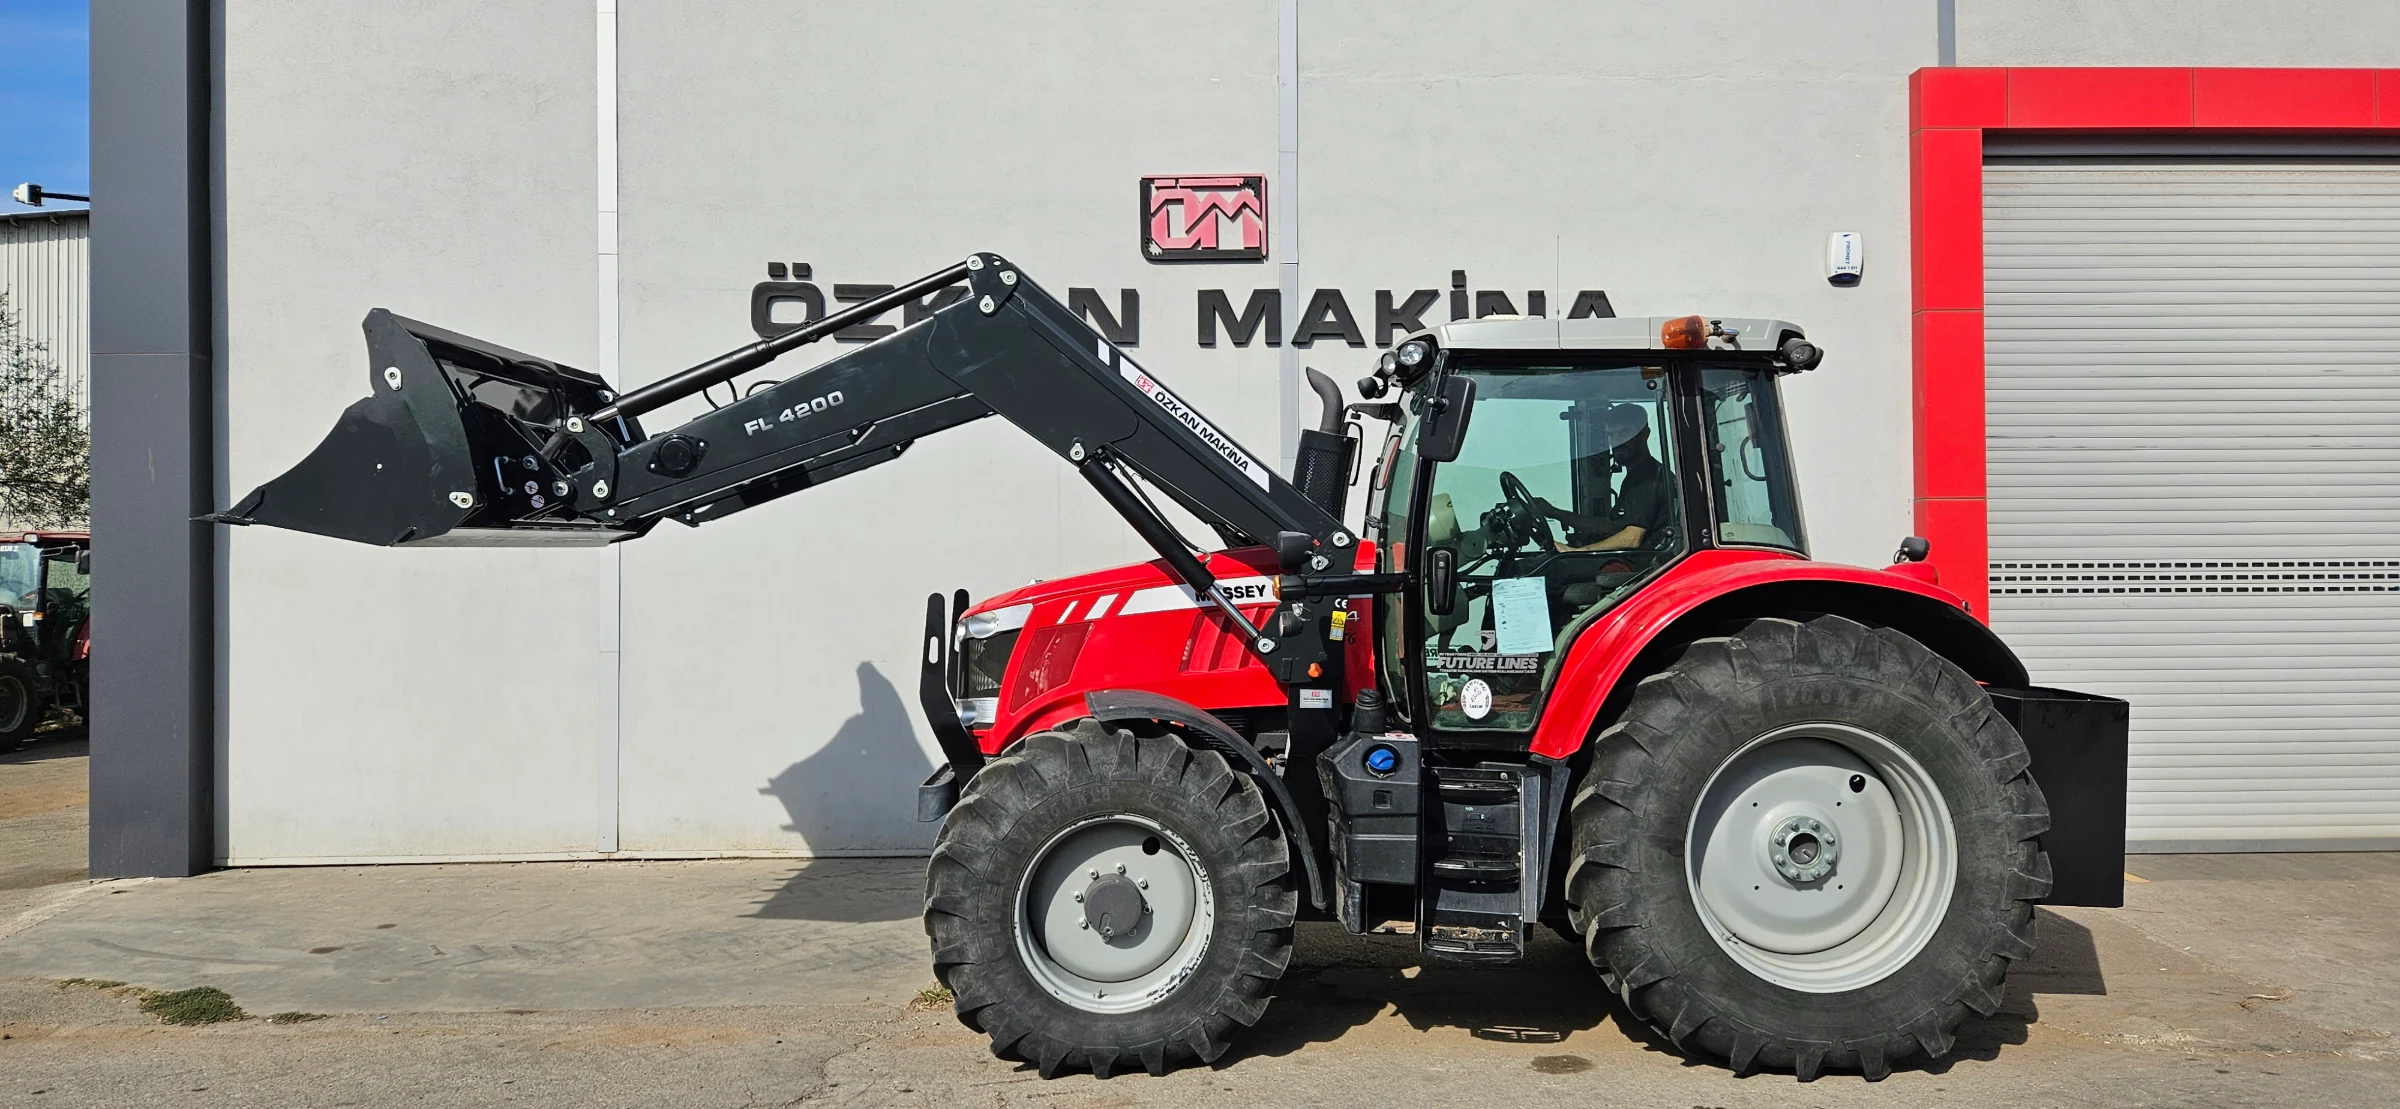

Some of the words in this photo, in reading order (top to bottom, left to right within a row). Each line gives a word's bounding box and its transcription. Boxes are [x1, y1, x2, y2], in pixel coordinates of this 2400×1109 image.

[751, 262, 1139, 347] ÖZN
[744, 417, 774, 436] FL
[779, 390, 844, 423] 4200
[1154, 390, 1200, 430] ÖZKAN
[1199, 426, 1250, 472] MAKİNA
[1195, 584, 1266, 602] SSEY
[1334, 598, 1348, 609] CE
[1436, 656, 1495, 669] FUTURE
[1496, 657, 1538, 669] LINES
